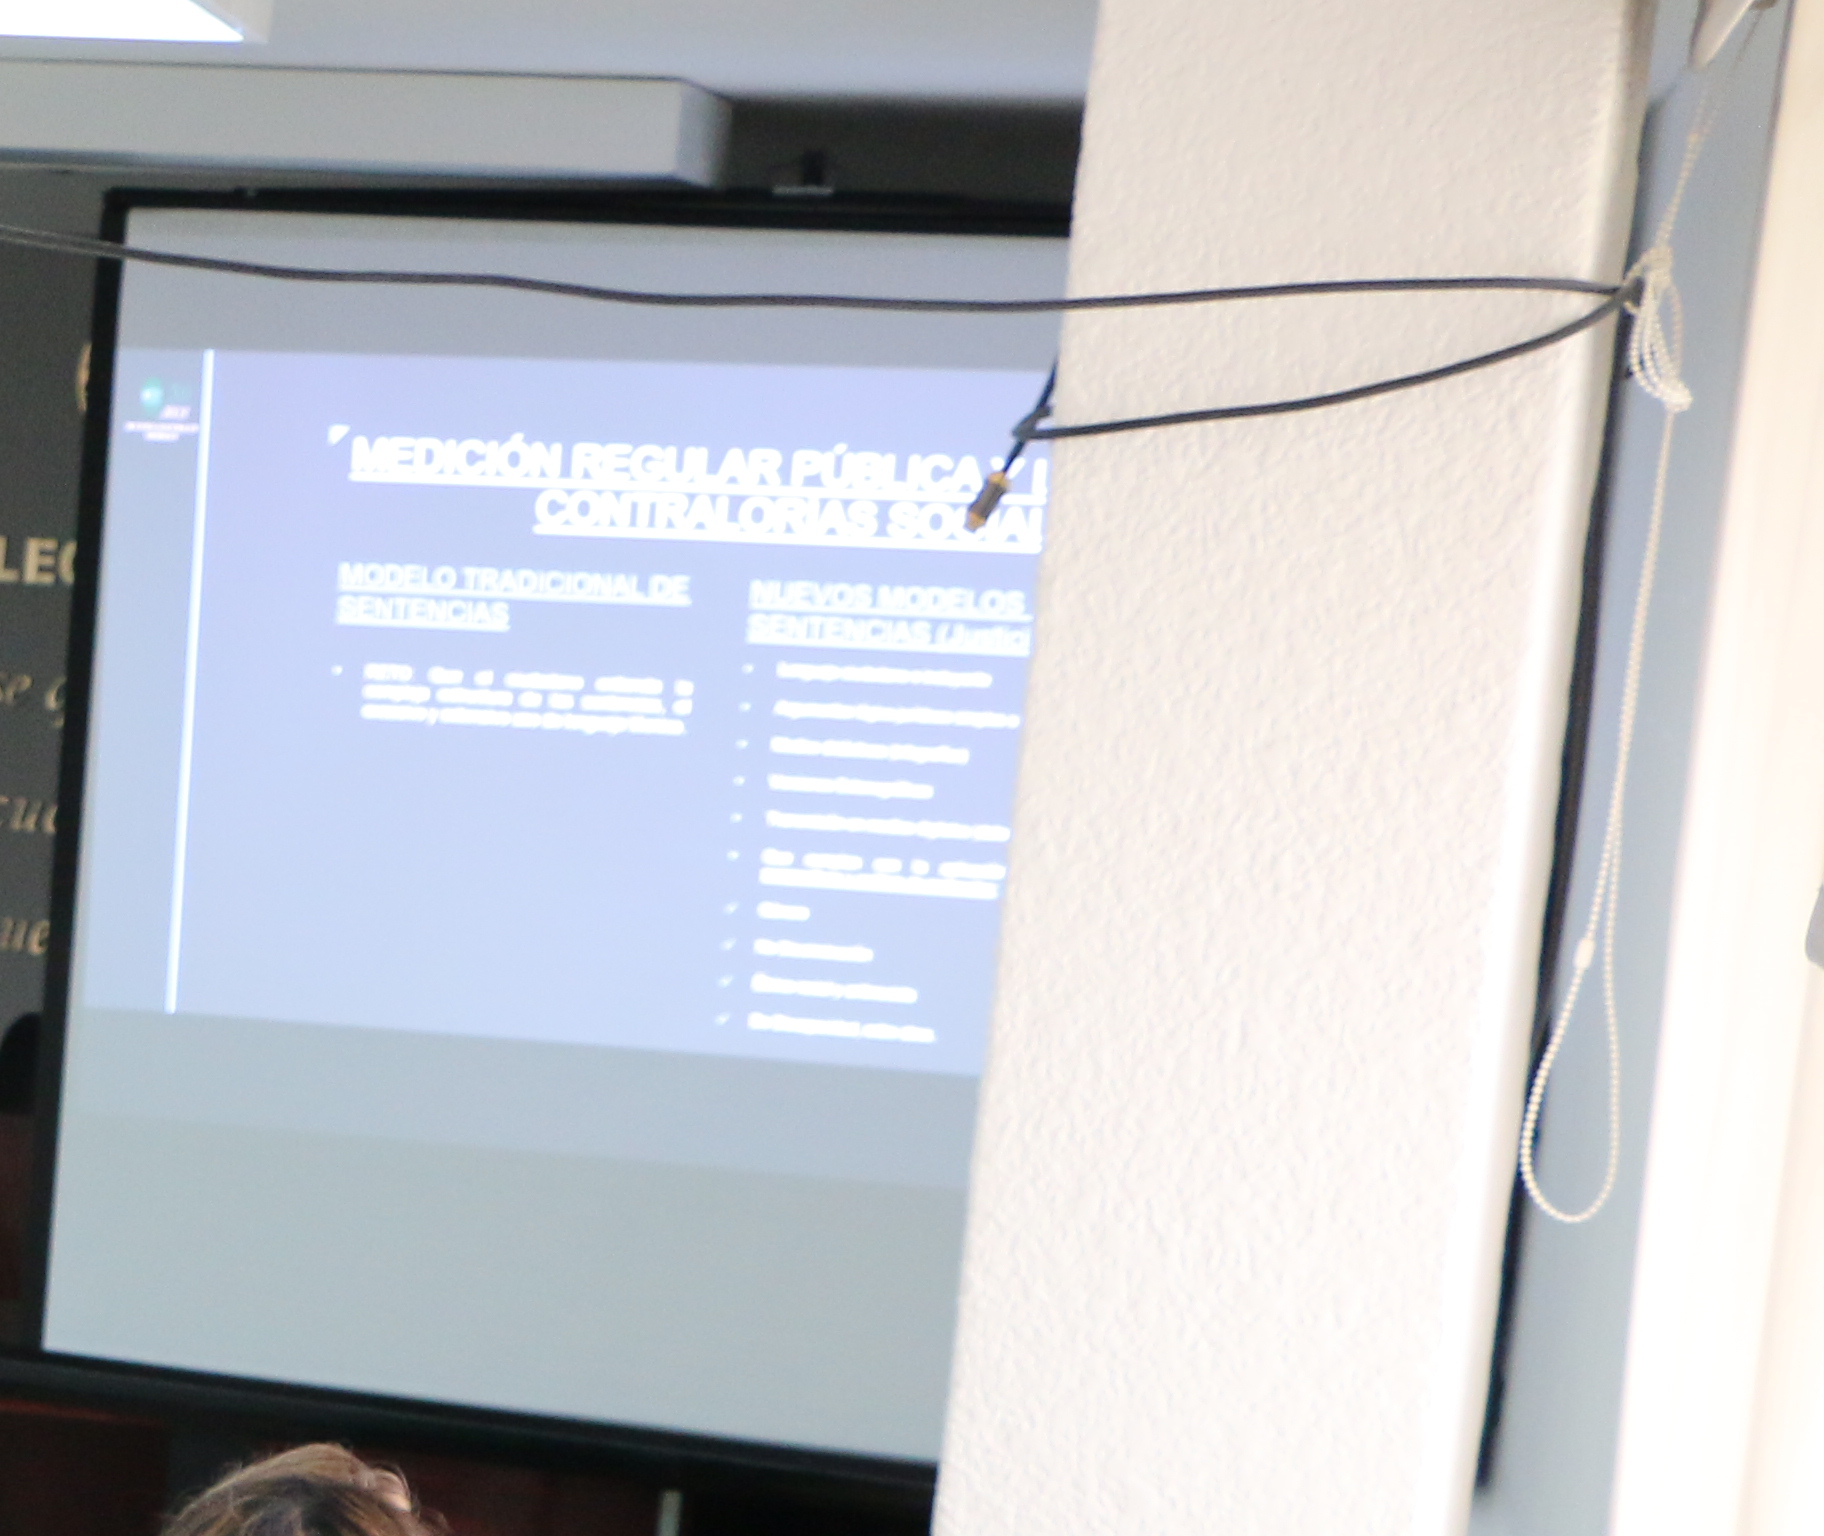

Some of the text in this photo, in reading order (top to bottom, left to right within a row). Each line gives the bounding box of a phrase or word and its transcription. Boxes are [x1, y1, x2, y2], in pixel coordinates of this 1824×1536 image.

[350, 433, 562, 484] MEDICIÓN
[571, 443, 781, 490] REGULAR
[791, 444, 982, 498] PÚBLICA
[534, 490, 879, 541] CONTRALORÍAS
[338, 562, 691, 605] MODELO TRADICIONAL DE
[748, 579, 1027, 618] NUEVOS MODELOS
[336, 594, 510, 628] SENTENCIAS
[746, 612, 932, 648] SENTENCIAS
